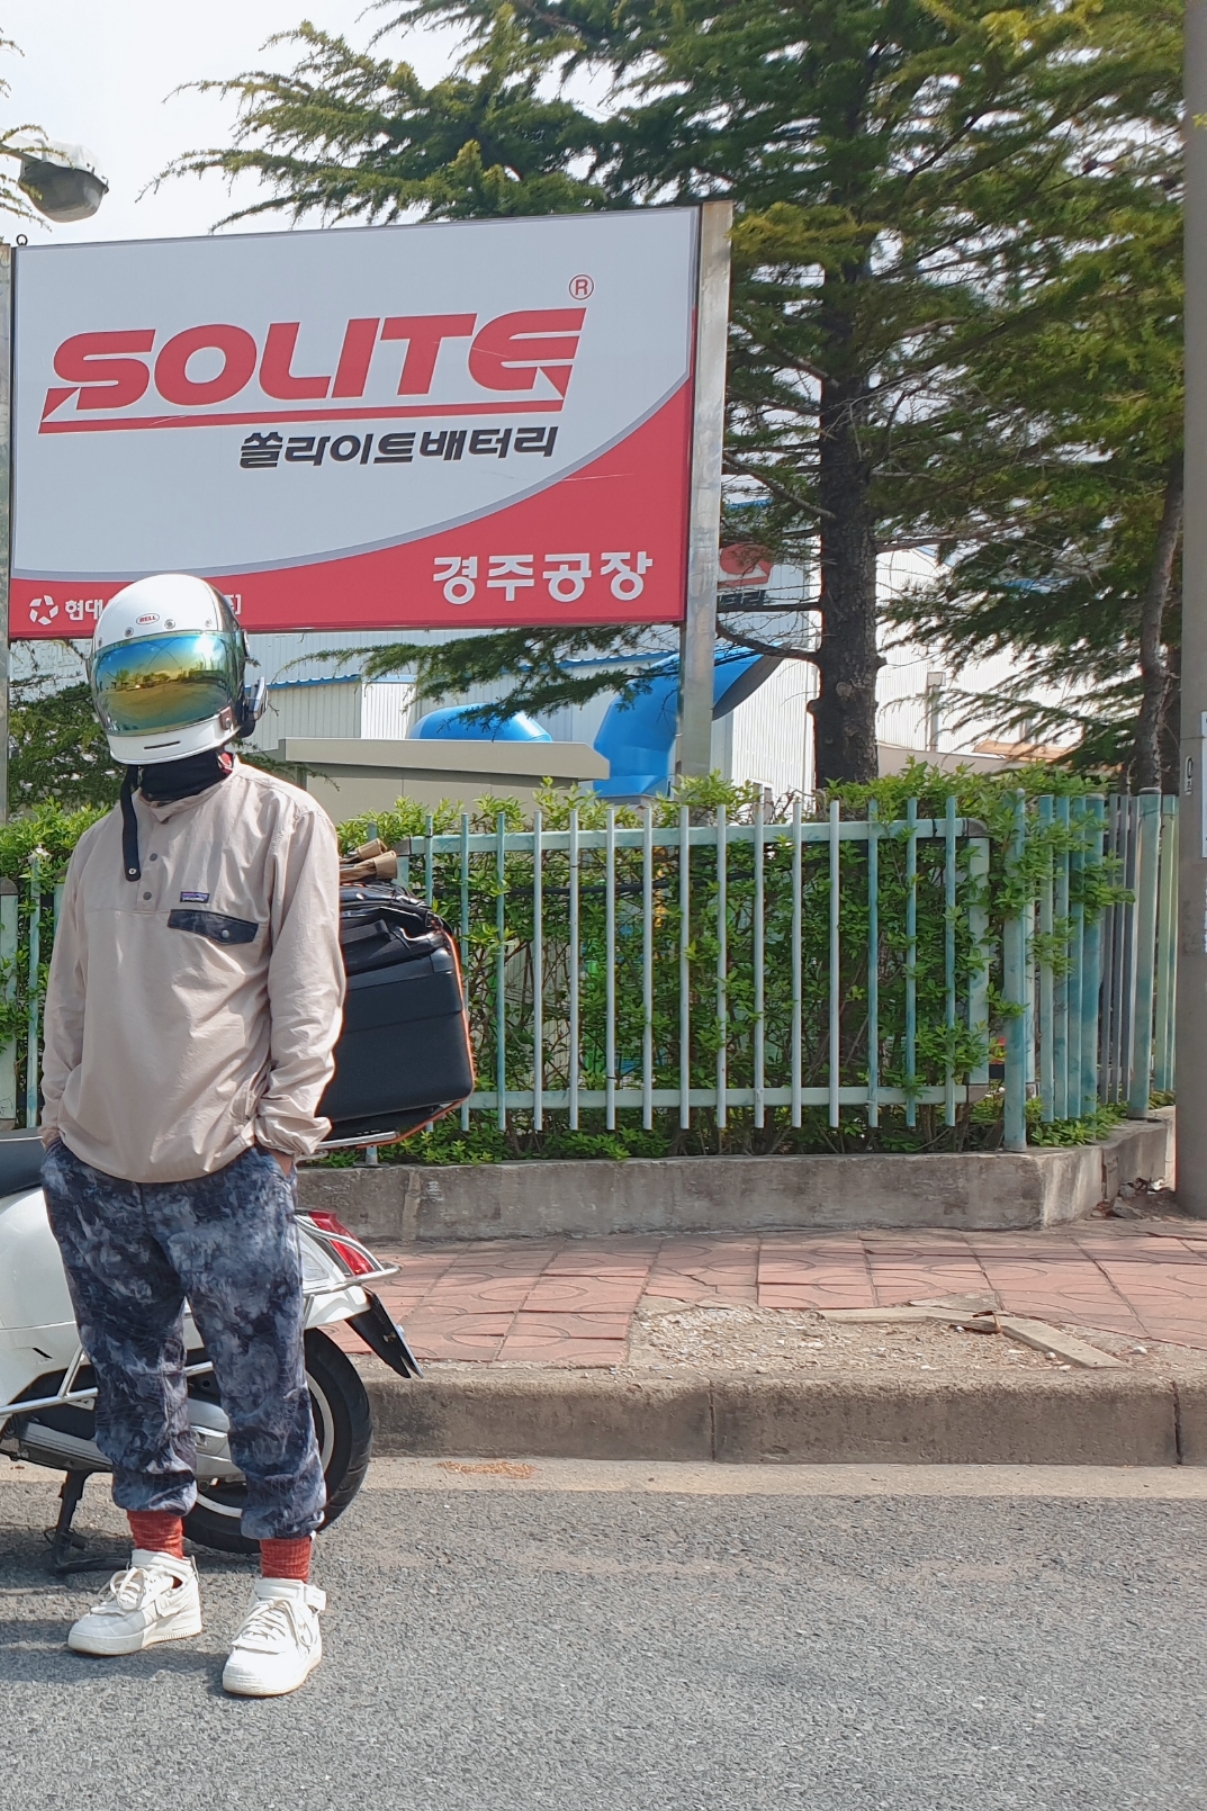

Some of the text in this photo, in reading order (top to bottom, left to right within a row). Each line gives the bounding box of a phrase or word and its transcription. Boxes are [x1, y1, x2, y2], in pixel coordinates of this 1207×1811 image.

[42, 308, 586, 412] SOLITE
[239, 426, 559, 468] 쏠라이트배터리
[433, 551, 653, 604] 경주공장
